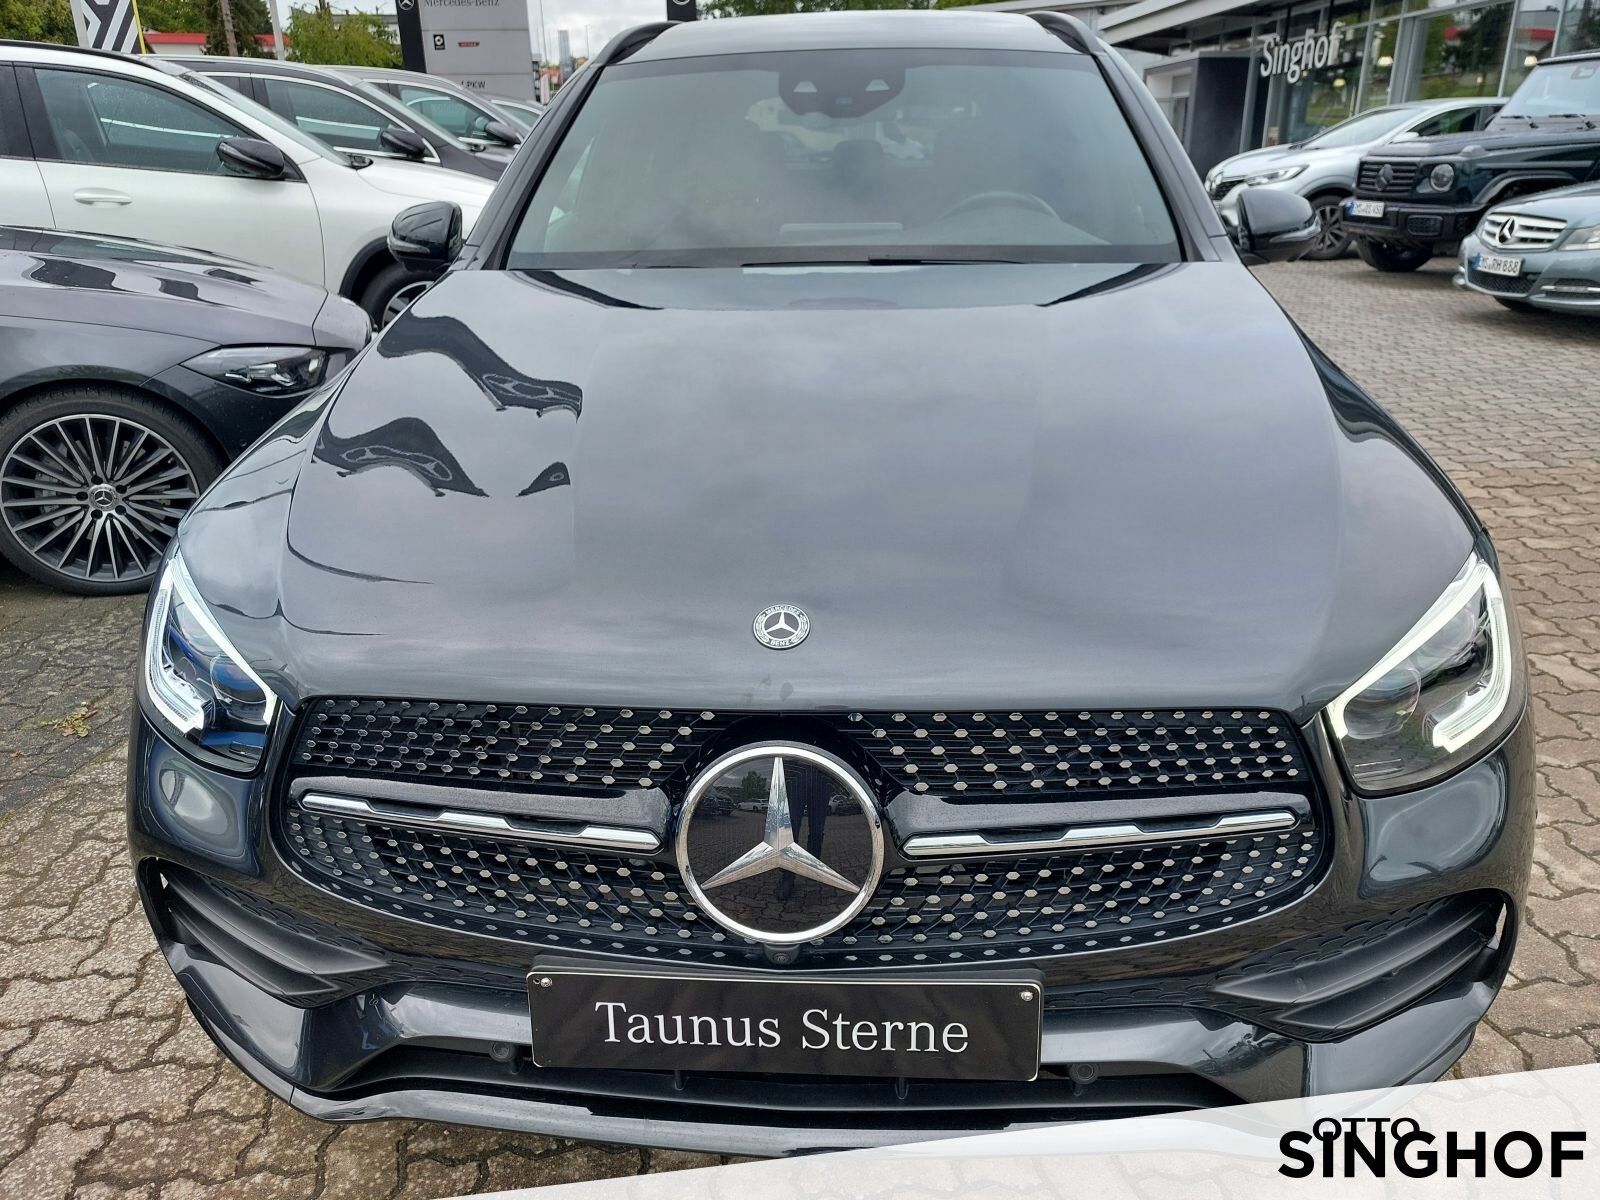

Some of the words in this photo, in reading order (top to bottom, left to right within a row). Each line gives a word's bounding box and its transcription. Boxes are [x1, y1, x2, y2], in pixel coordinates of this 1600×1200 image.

[1260, 21, 1345, 83] Singhof
[595, 1001, 781, 1049] Taunus
[801, 1008, 969, 1053] Sterne
